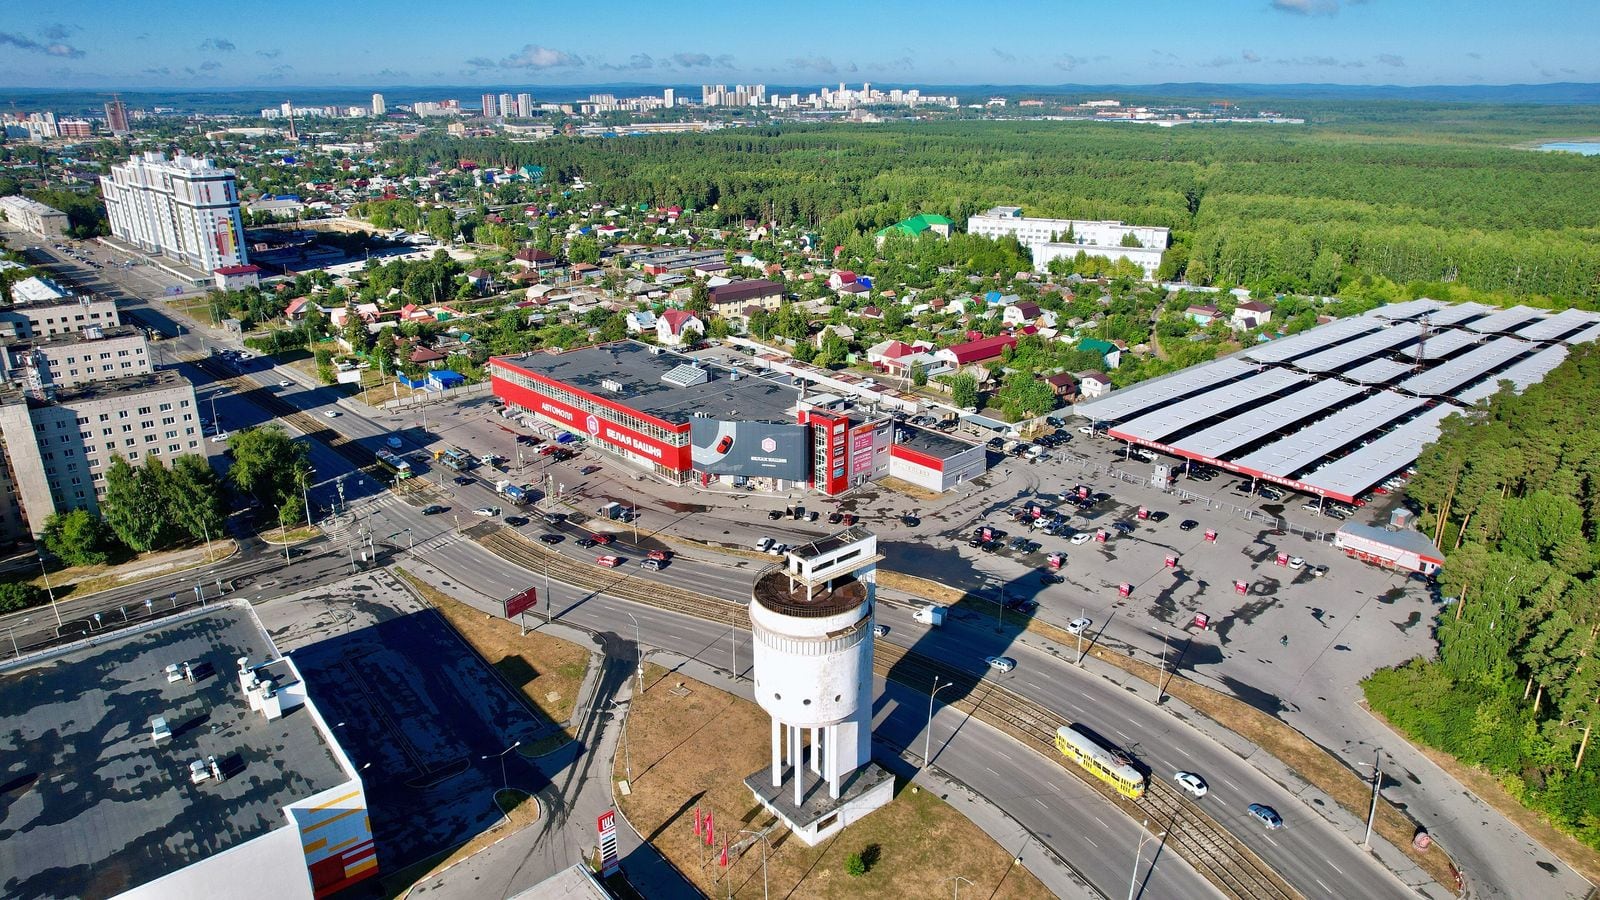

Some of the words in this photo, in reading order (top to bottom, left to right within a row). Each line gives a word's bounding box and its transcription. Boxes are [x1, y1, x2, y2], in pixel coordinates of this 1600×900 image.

[541, 403, 573, 421] АВТОМОЛЛ
[606, 429, 632, 446] БЕЛАЯ
[633, 439, 662, 458] БАШНЯ
[1262, 473, 1301, 488] ПРОДАЖА
[1304, 485, 1325, 495] АВТО
